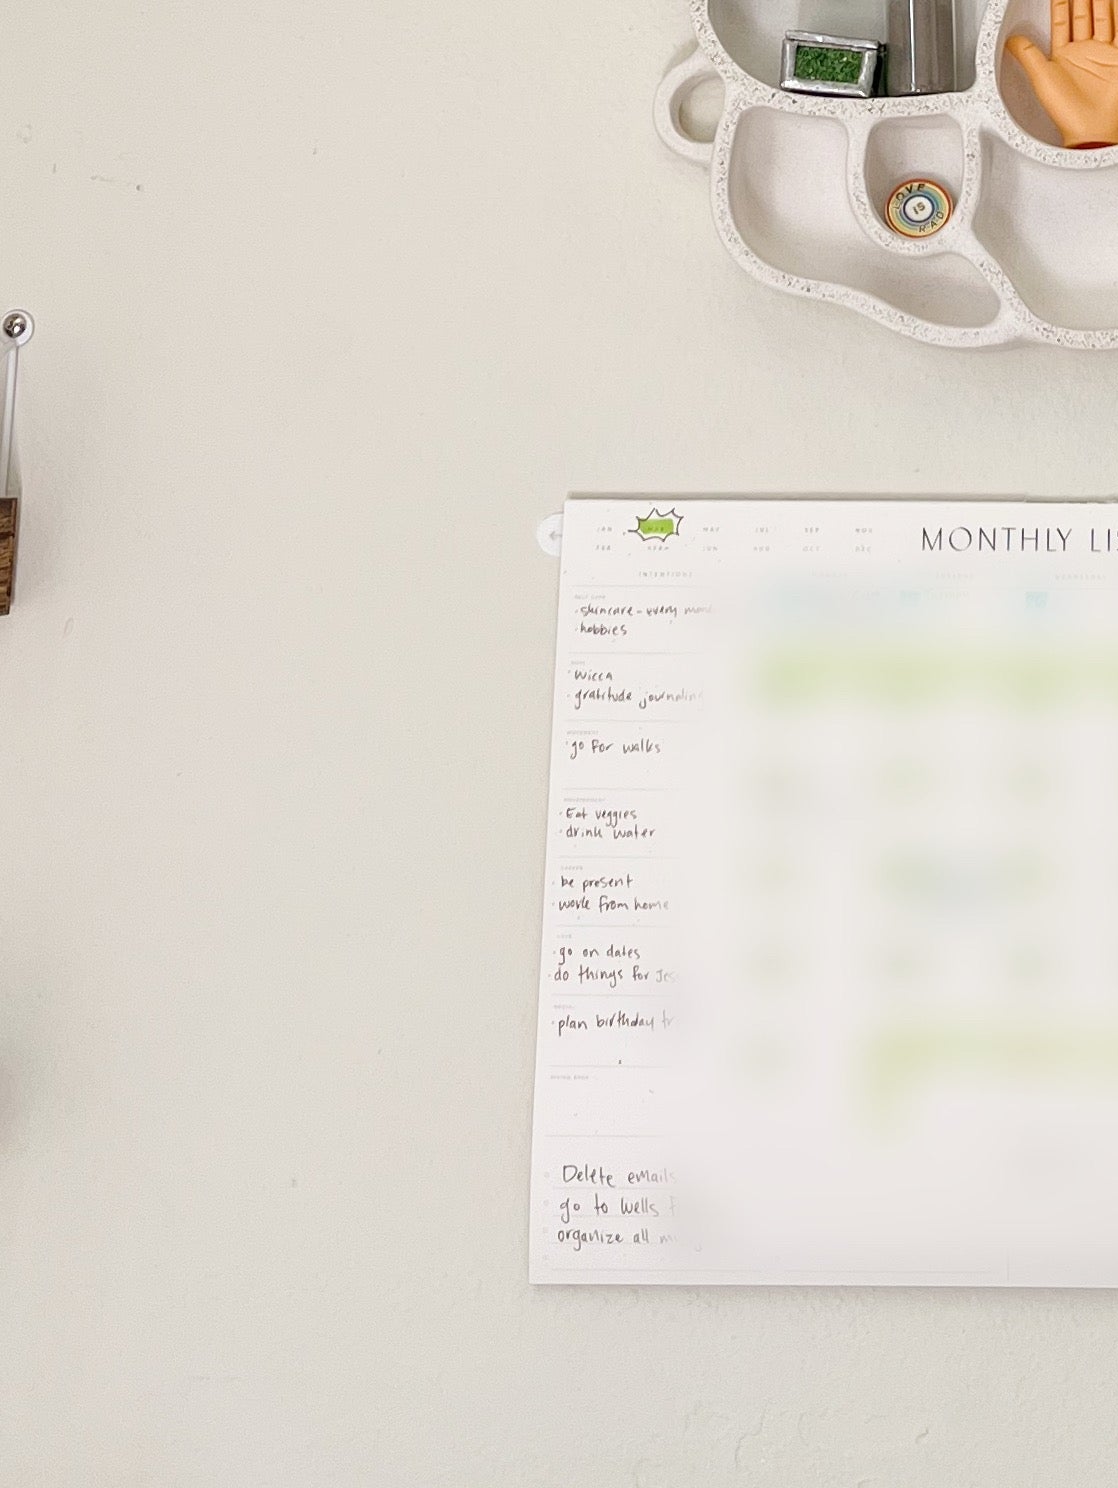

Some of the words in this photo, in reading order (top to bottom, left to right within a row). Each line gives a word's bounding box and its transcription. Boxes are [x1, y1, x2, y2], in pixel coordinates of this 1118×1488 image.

[893, 183, 925, 210] LOVE
[913, 202, 926, 215] IS
[919, 211, 944, 233] RAD
[921, 526, 1073, 552] MONTHLY
[580, 604, 633, 617] skincare
[580, 622, 628, 636] hobbies
[574, 686, 632, 710] gratitude
[570, 740, 585, 760] go
[622, 738, 661, 754] walks
[566, 807, 587, 820] Eat
[595, 809, 638, 828] veggies
[566, 825, 603, 839] drink
[613, 824, 656, 839] water
[561, 875, 574, 888] be
[582, 874, 634, 893] present
[558, 896, 591, 911] work
[598, 895, 629, 913] from
[634, 897, 669, 912] home
[558, 946, 573, 966] go
[582, 947, 600, 958] on
[606, 944, 641, 960] dates
[554, 965, 569, 982] do
[578, 964, 624, 989] things
[632, 965, 650, 982] for
[558, 1014, 588, 1038] plan
[596, 1010, 656, 1031] birthday
[562, 1163, 616, 1189] Delete
[559, 1197, 581, 1224] go
[594, 1193, 609, 1216] to
[557, 1228, 625, 1252] organize
[633, 1228, 650, 1244] all
